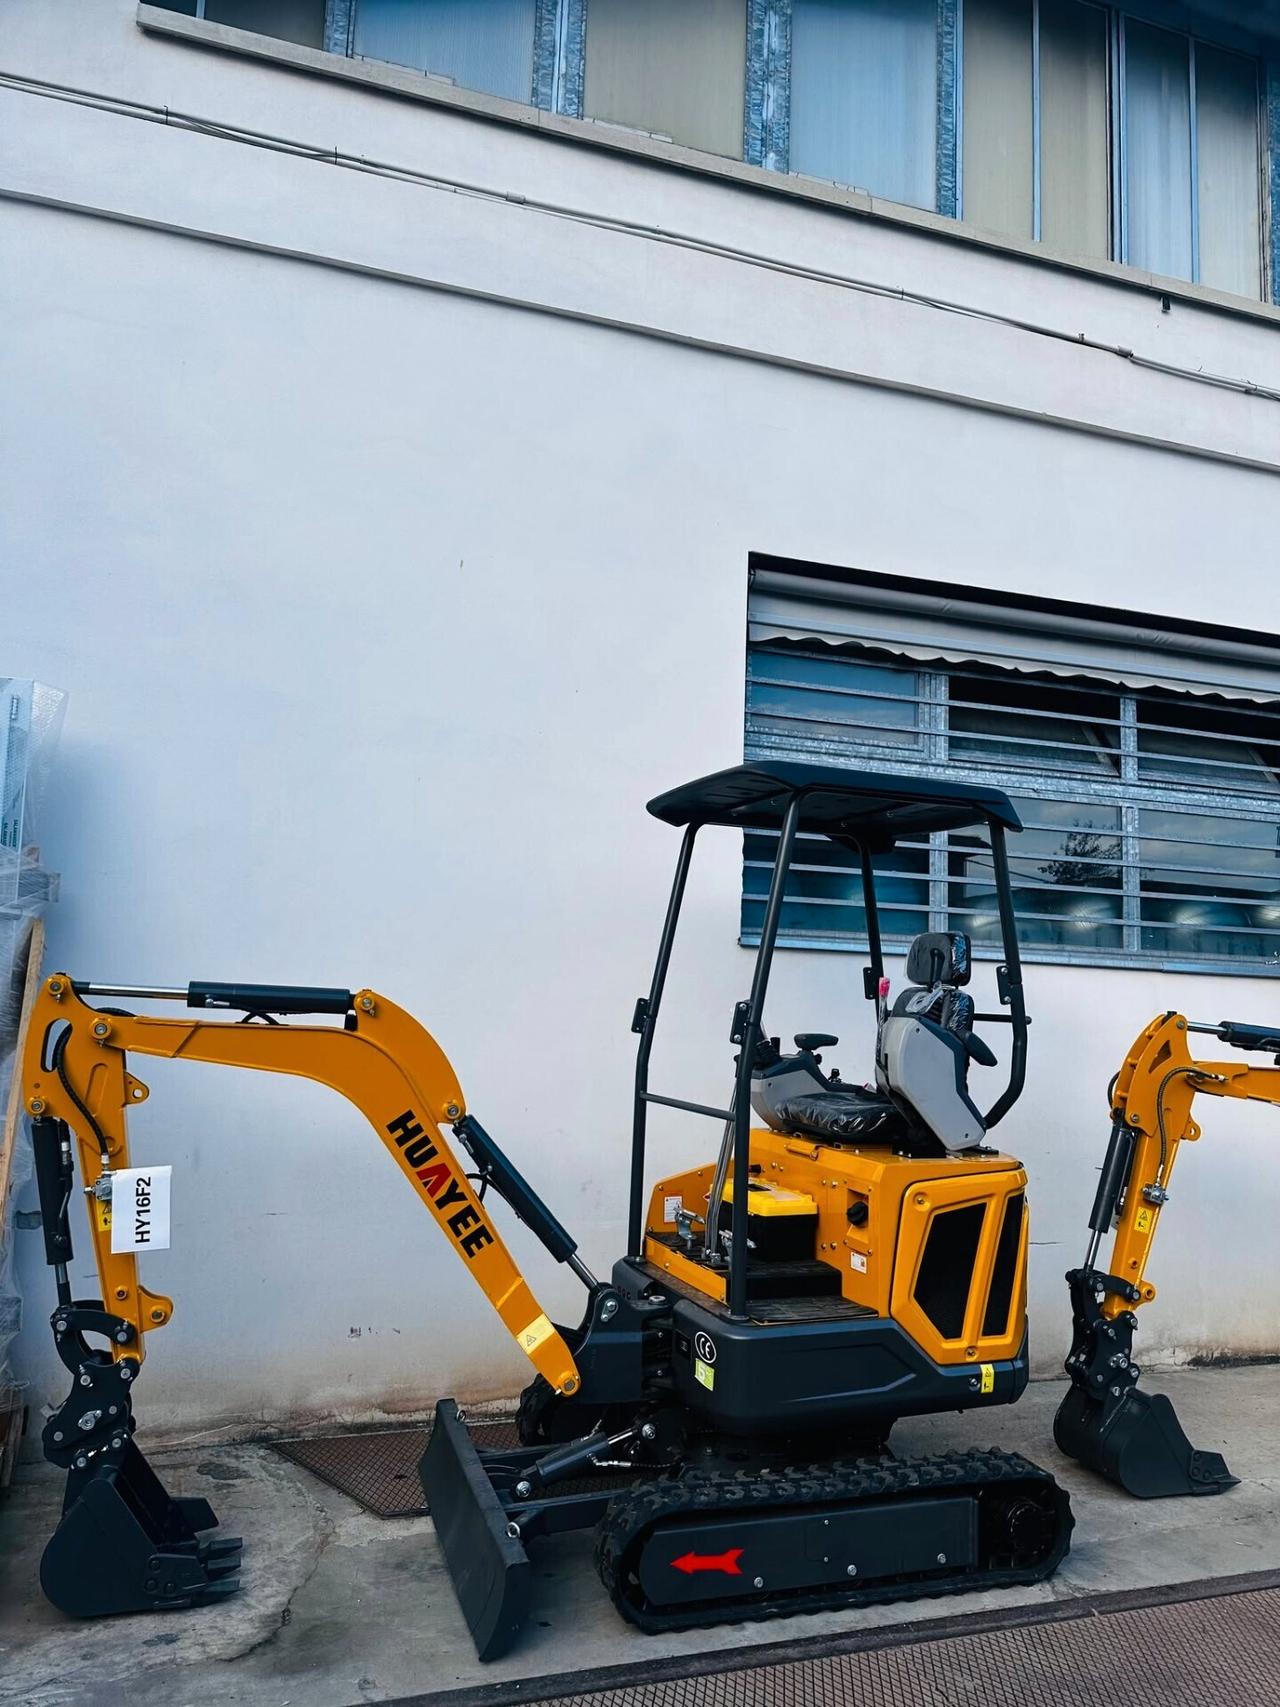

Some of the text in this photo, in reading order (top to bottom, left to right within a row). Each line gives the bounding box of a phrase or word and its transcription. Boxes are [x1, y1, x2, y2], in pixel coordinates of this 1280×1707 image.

[135, 1176, 151, 1244] HY16F2
[386, 1109, 495, 1259] HUAYEE
[700, 1337, 711, 1359] CE
